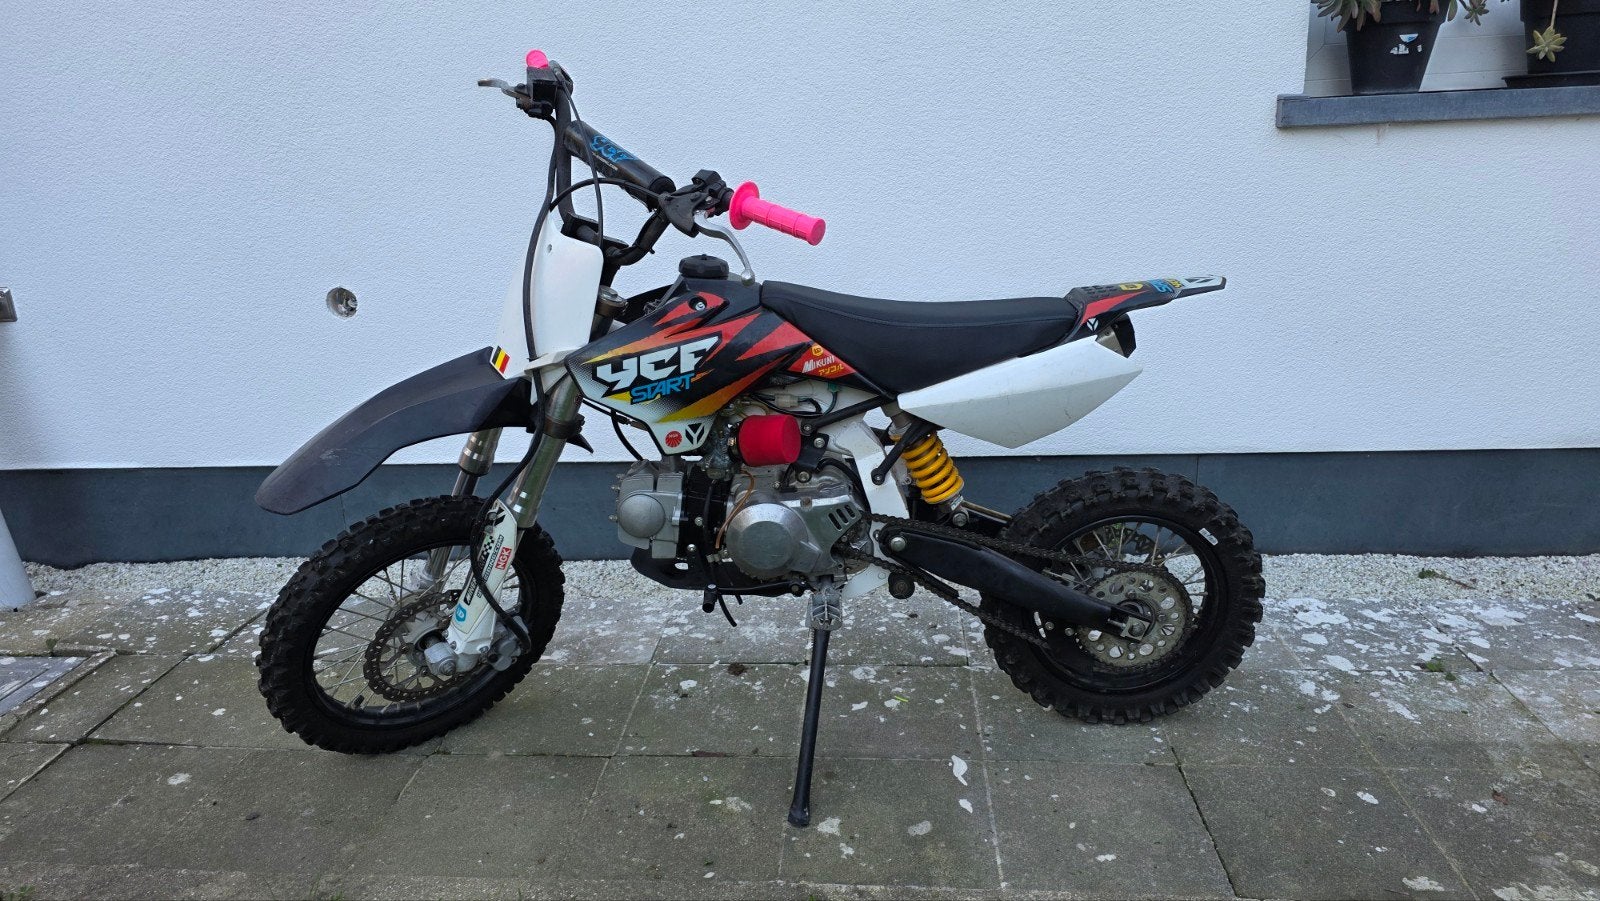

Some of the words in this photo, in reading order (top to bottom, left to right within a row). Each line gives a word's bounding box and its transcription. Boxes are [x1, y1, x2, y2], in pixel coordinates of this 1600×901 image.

[596, 335, 719, 391] YCF
[631, 372, 695, 404] START
[496, 547, 512, 570] NGK
